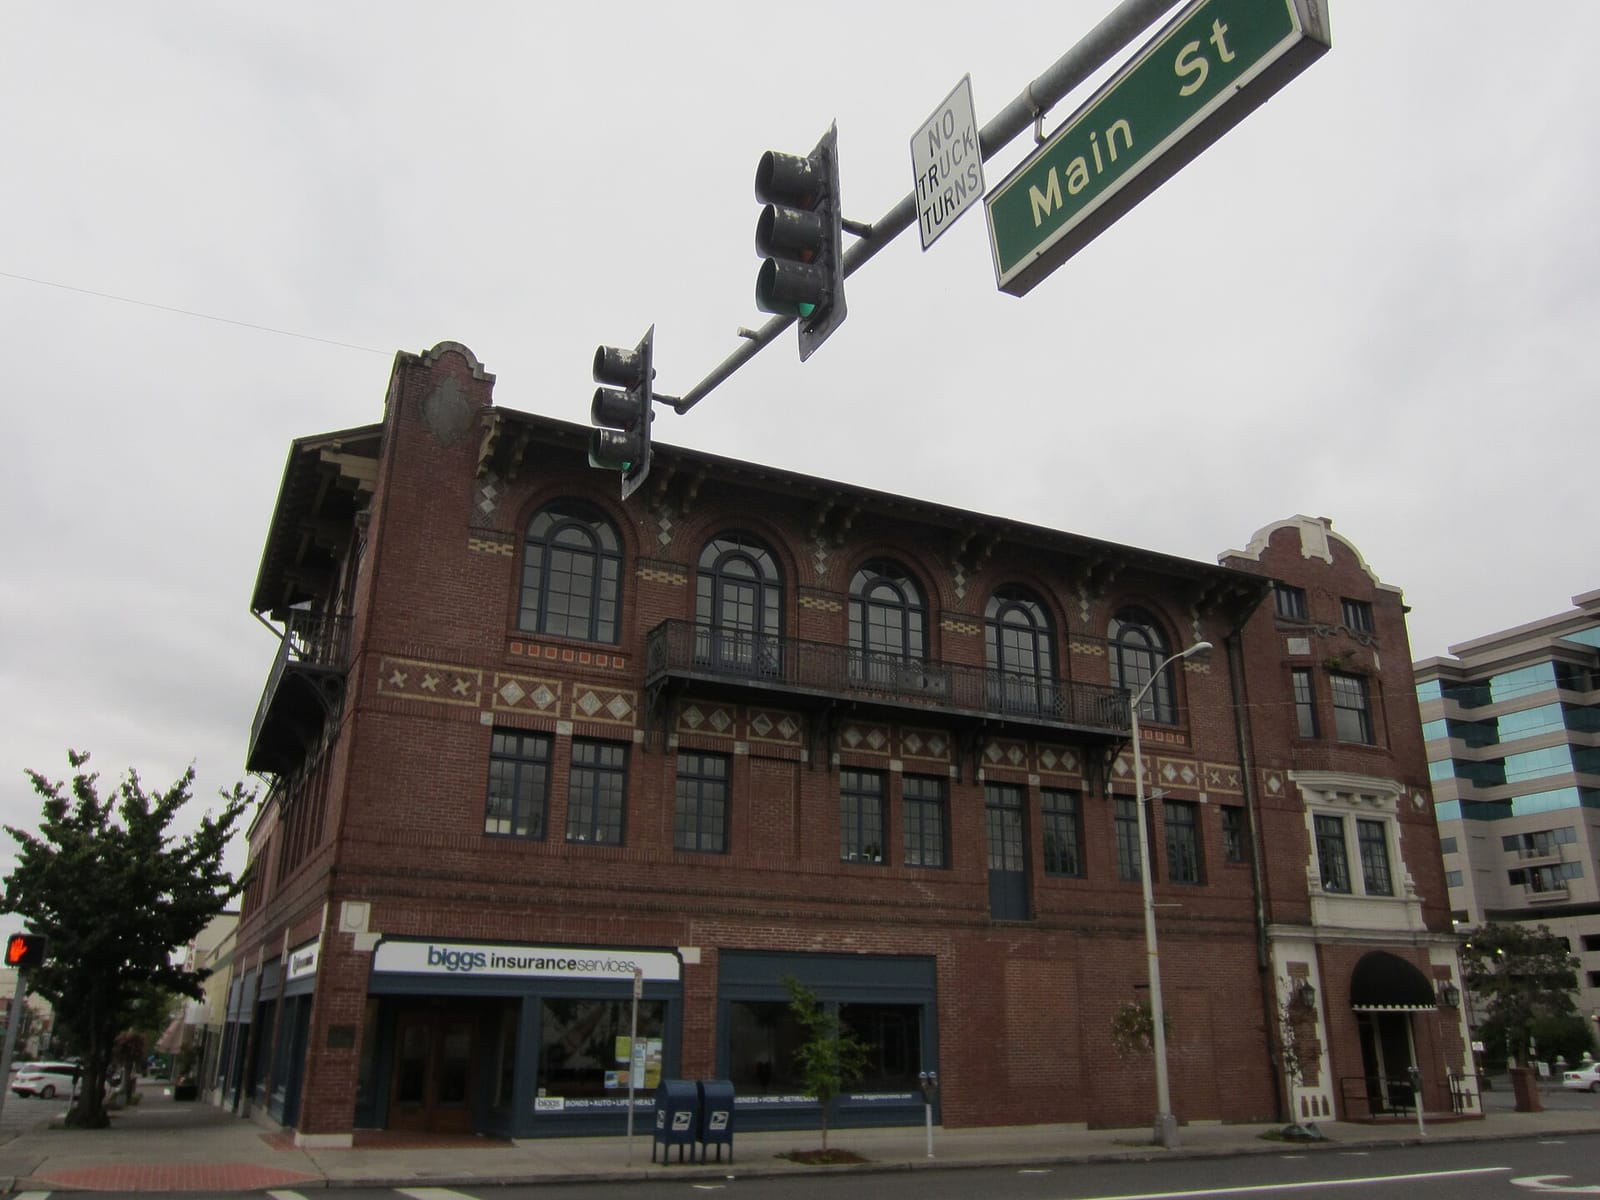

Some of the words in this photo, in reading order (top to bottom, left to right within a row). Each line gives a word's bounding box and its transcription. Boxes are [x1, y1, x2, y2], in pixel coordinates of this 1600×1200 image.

[928, 108, 955, 158] NO
[1028, 119, 1134, 228] Main
[1174, 18, 1236, 97] St
[918, 125, 975, 201] TRUCK
[923, 162, 979, 235] TURNS
[427, 944, 487, 972] biggs
